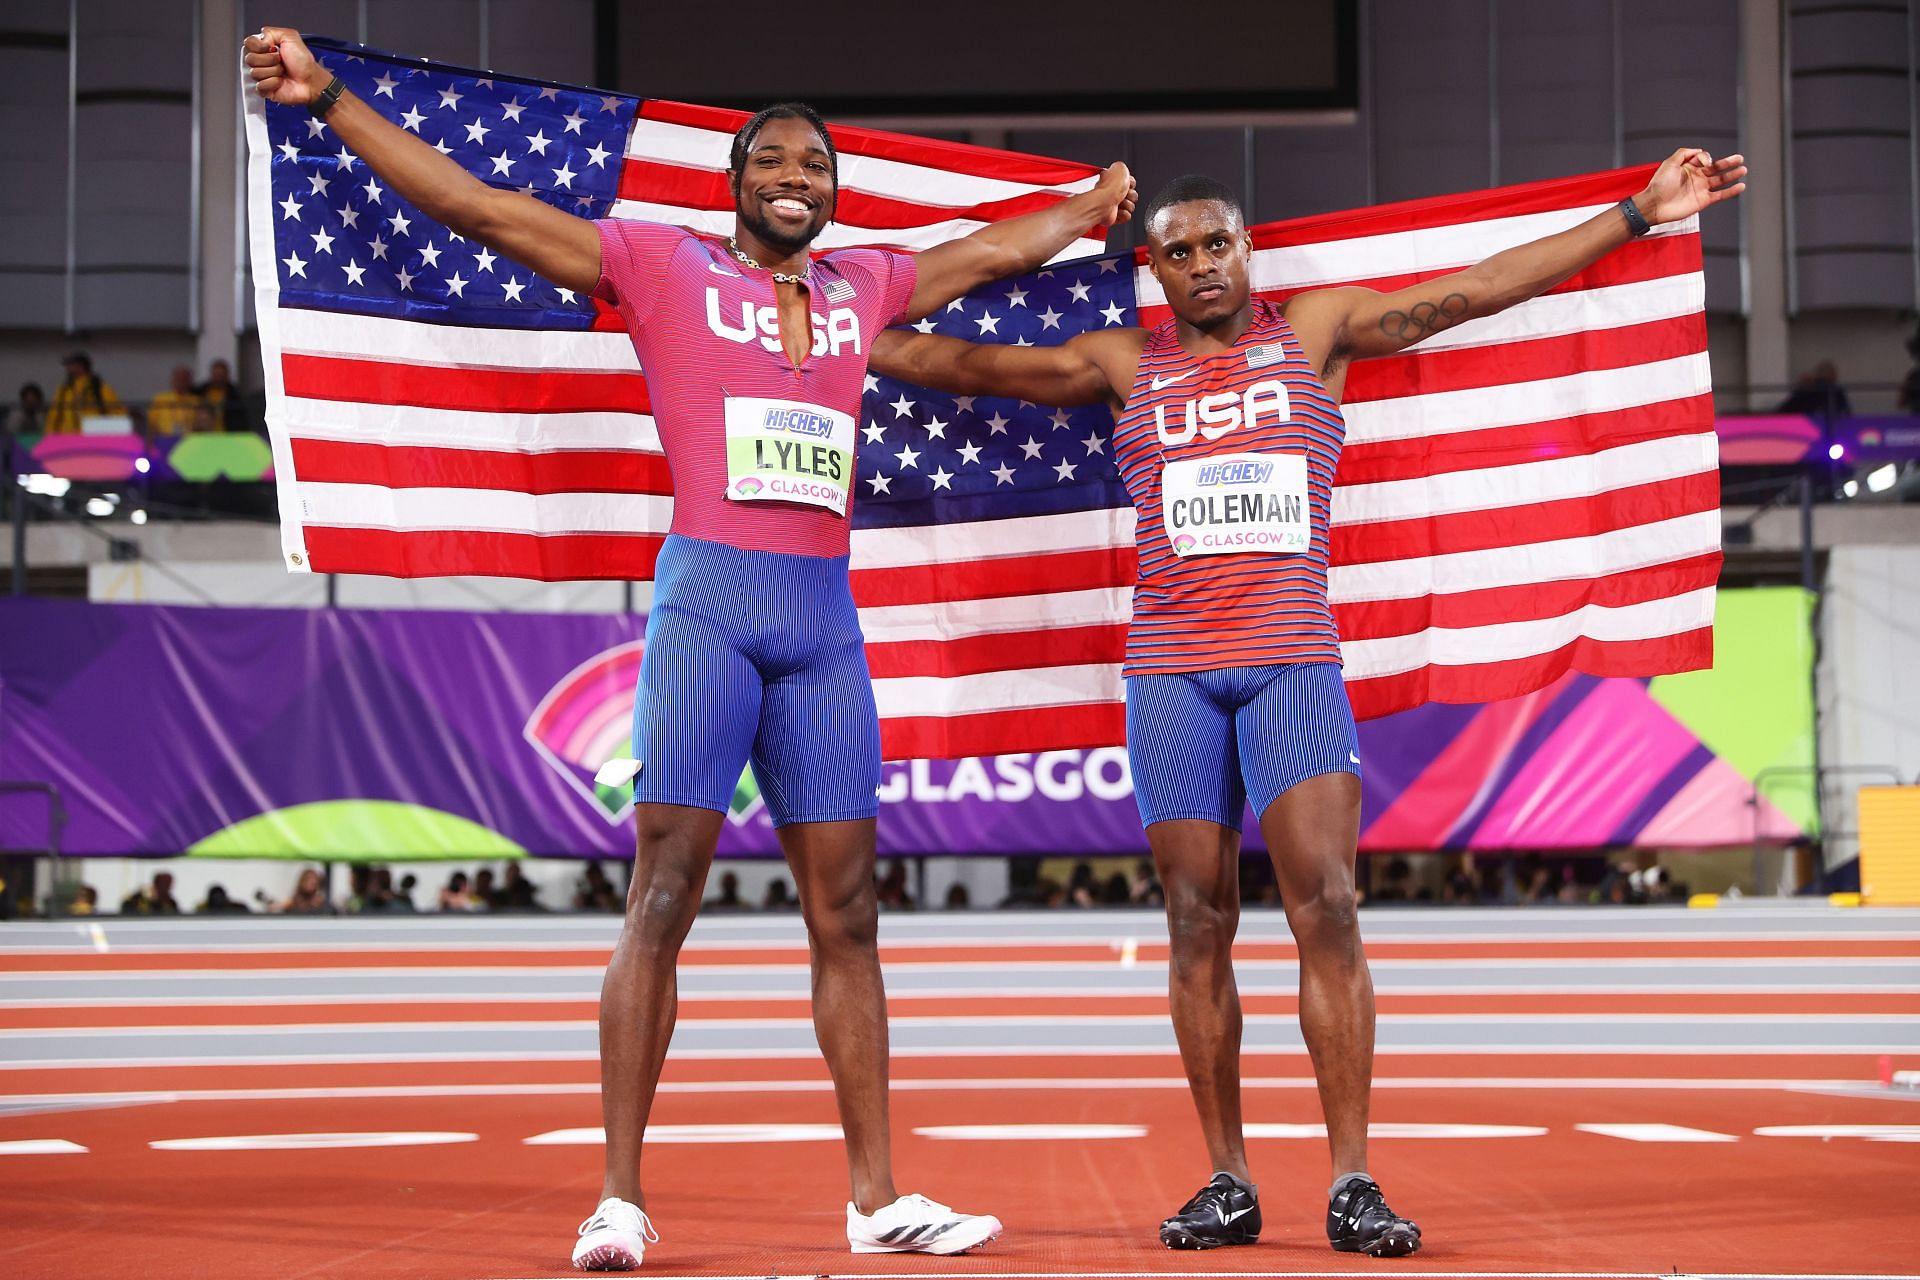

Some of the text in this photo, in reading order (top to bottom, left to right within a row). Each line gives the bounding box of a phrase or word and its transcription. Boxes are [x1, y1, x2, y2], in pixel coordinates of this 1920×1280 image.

[706, 287, 861, 357] USA
[1154, 379, 1291, 447] USA
[755, 440, 841, 480] LYLES
[770, 480, 838, 502] GLASGOW
[1172, 493, 1301, 529] COLEMAN
[1202, 532, 1305, 547] GLASGOW 24
